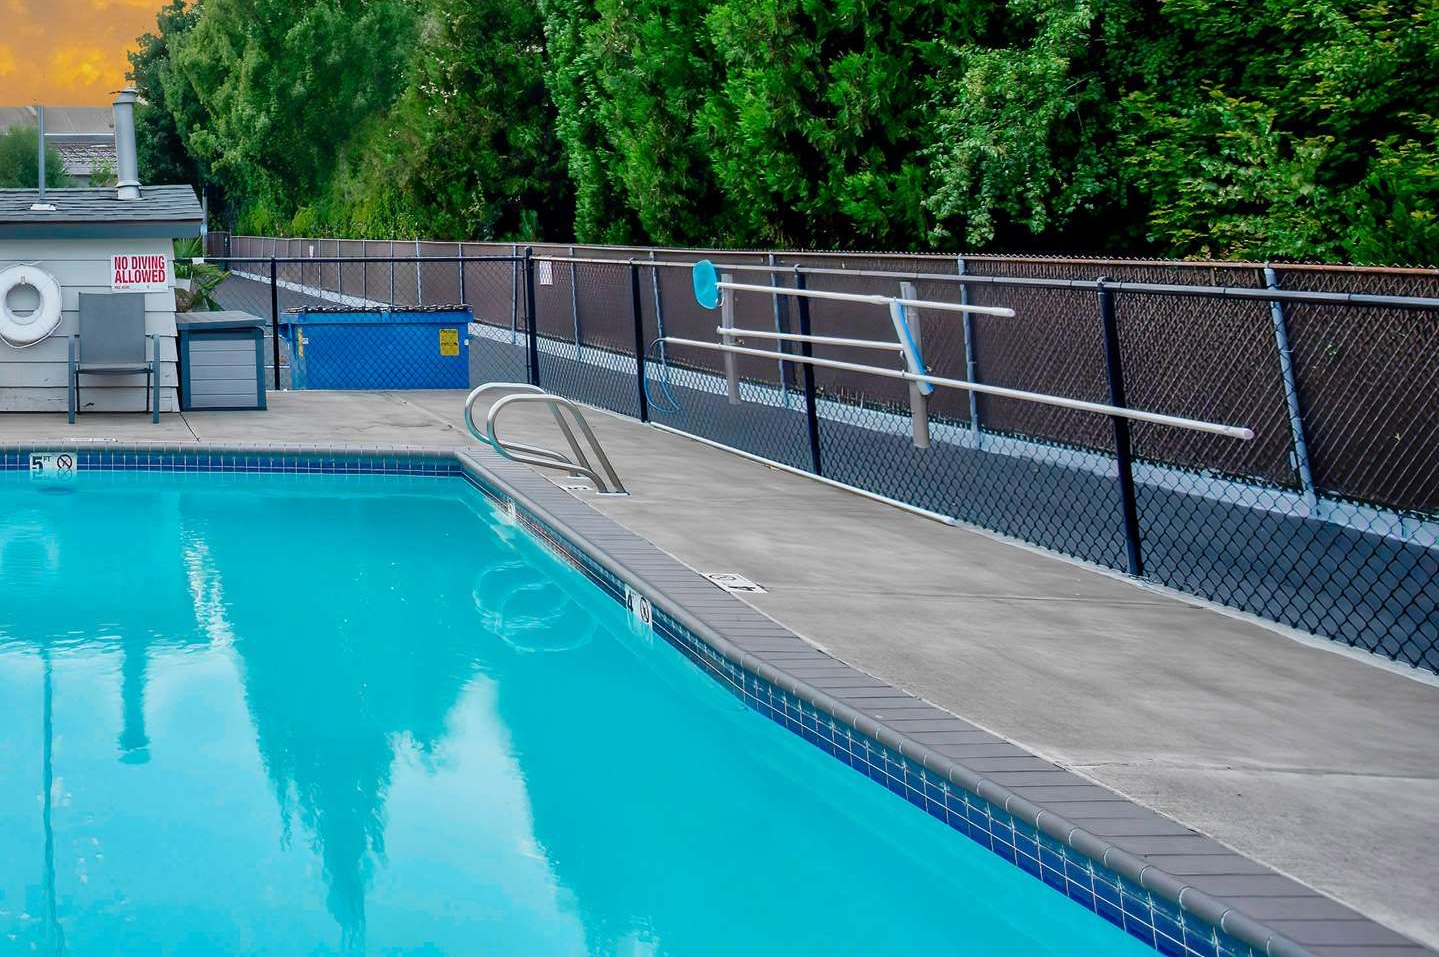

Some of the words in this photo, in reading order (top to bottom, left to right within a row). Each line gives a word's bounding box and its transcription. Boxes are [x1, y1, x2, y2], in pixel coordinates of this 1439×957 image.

[114, 256, 128, 270] NO
[131, 255, 165, 270] DIVING
[114, 270, 166, 283] ALLOWED
[32, 455, 43, 470] 5
